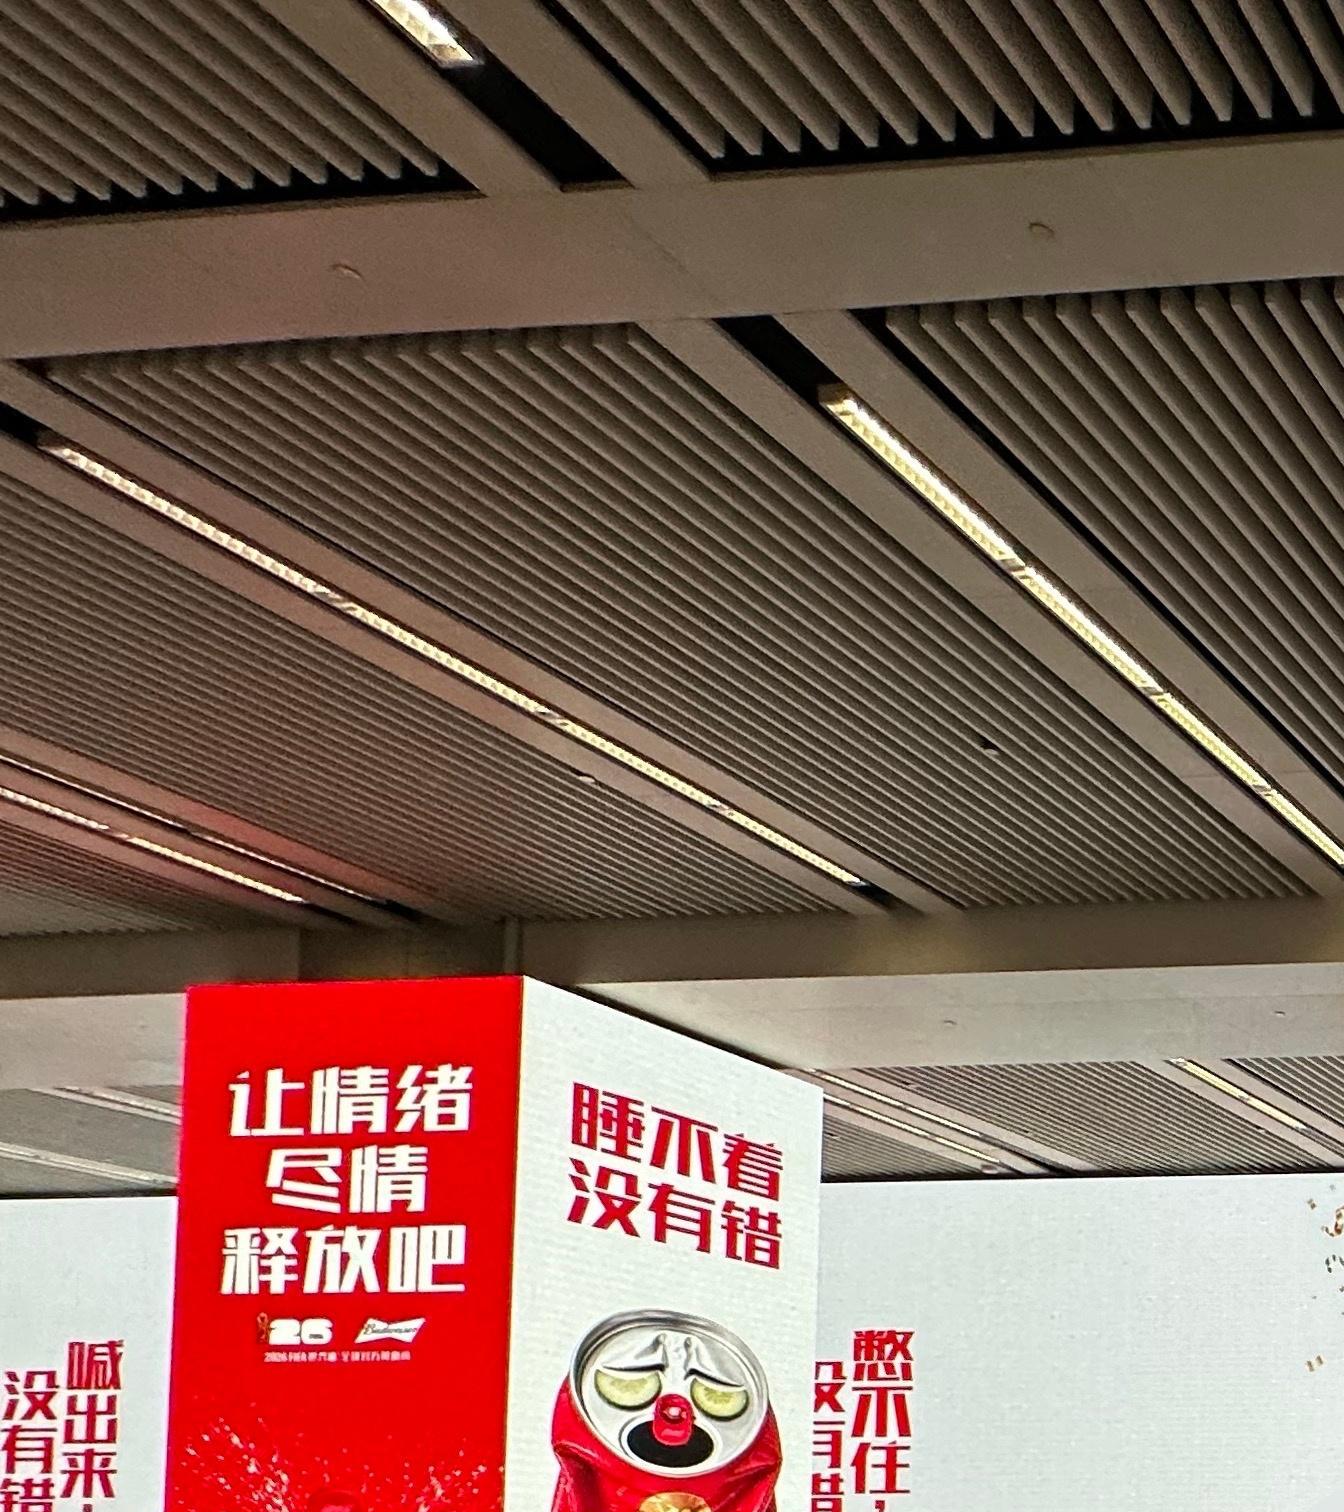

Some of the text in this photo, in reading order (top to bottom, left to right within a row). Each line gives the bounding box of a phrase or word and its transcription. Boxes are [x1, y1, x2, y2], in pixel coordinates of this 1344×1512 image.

[229, 1064, 473, 1137] 让情绪
[570, 1081, 783, 1202] 睡不着
[266, 1144, 428, 1213] 尽情
[567, 1157, 782, 1270] 没有错
[221, 1224, 466, 1295] 释放吧
